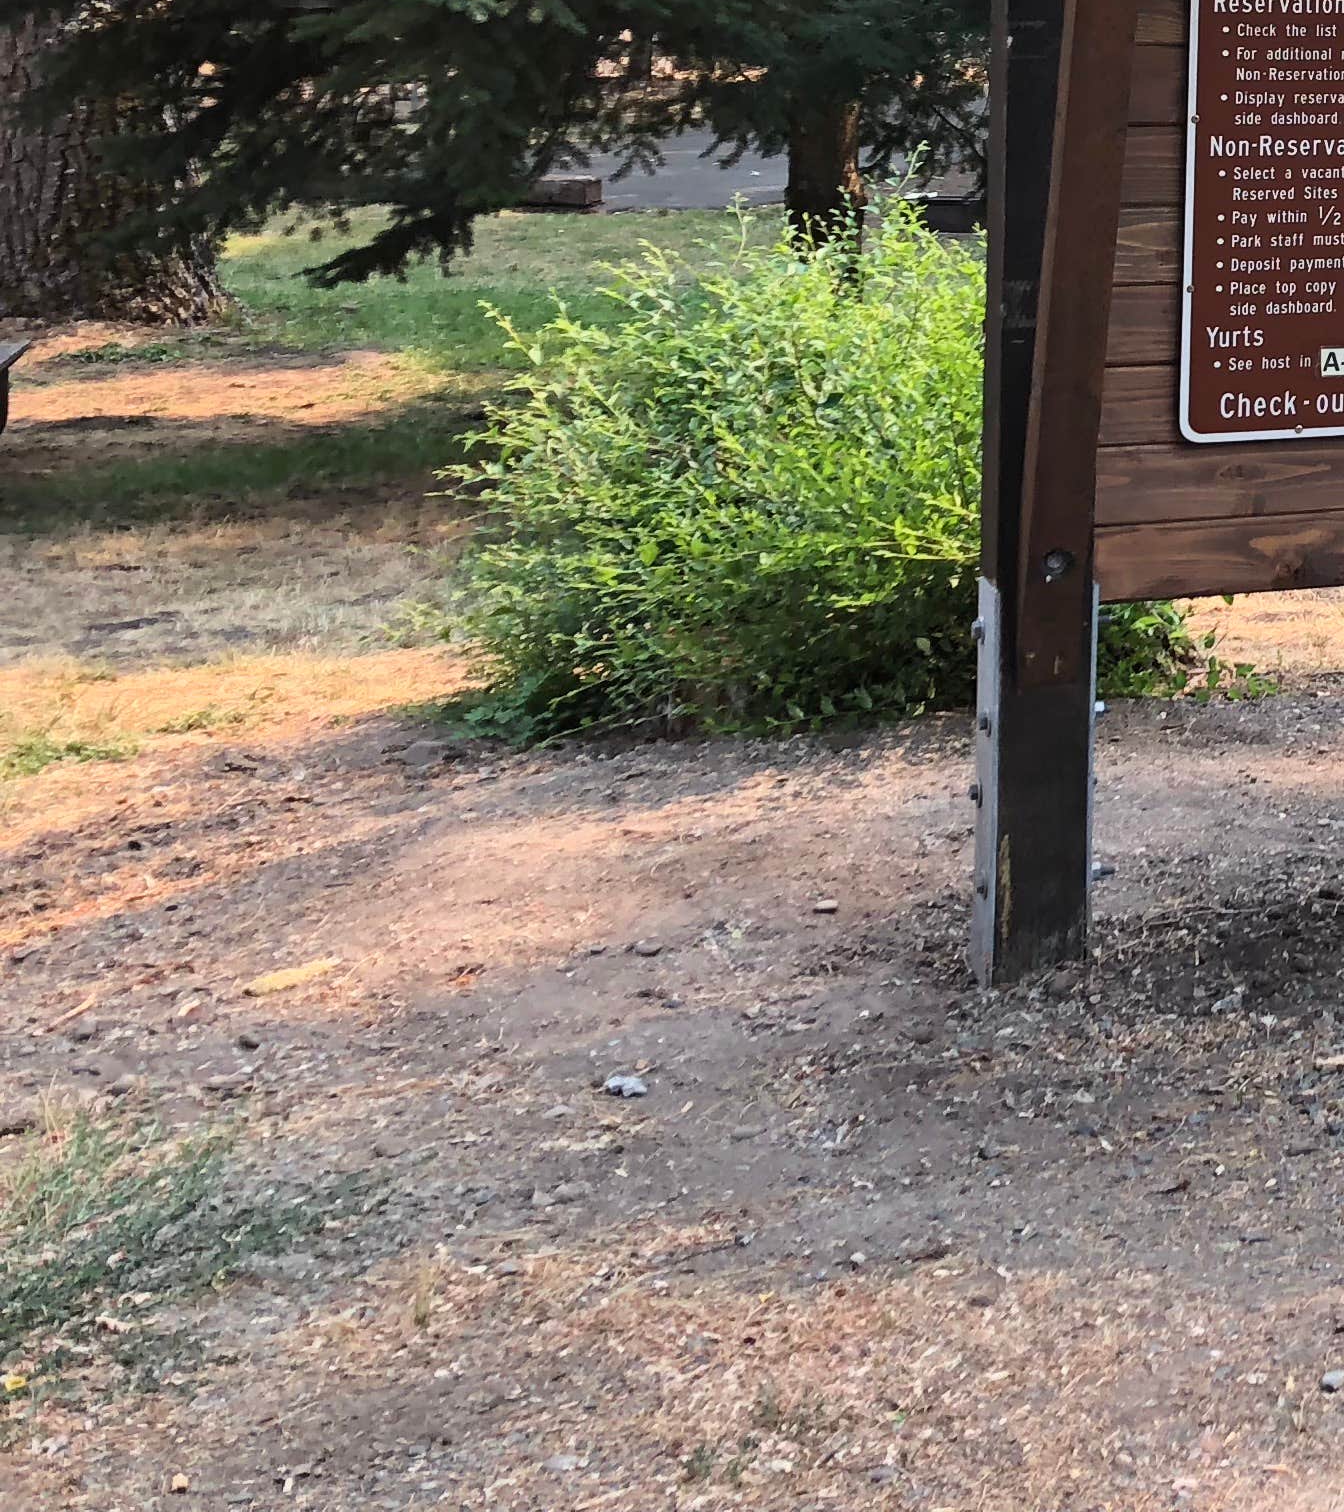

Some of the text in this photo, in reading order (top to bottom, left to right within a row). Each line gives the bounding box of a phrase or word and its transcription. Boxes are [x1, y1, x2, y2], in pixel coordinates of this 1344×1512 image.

[1237, 23, 1276, 36] Check
[1286, 24, 1306, 37] the
[1316, 24, 1337, 37] list
[1237, 47, 1257, 60] For
[1266, 47, 1331, 60] additional
[1235, 91, 1285, 107] Display
[1235, 112, 1342, 125] side dashboard.
[1234, 167, 1275, 180] Select
[1285, 169, 1292, 179] a
[1233, 187, 1294, 200] Reserved
[1304, 186, 1338, 199] Sites
[1232, 211, 1257, 227] Pay
[1267, 210, 1307, 223] within
[1232, 235, 1261, 248] Park
[1270, 233, 1303, 247] staff
[1313, 233, 1344, 245] must
[1231, 257, 1280, 274] Deposit
[1230, 282, 1266, 295] Place
[1276, 281, 1296, 296] top
[1306, 279, 1336, 295] copy
[1230, 299, 1336, 316] side dashboard.
[1206, 326, 1263, 348] Yurts
[1229, 357, 1252, 371] See
[1262, 355, 1290, 369] host
[1300, 355, 1311, 367] in
